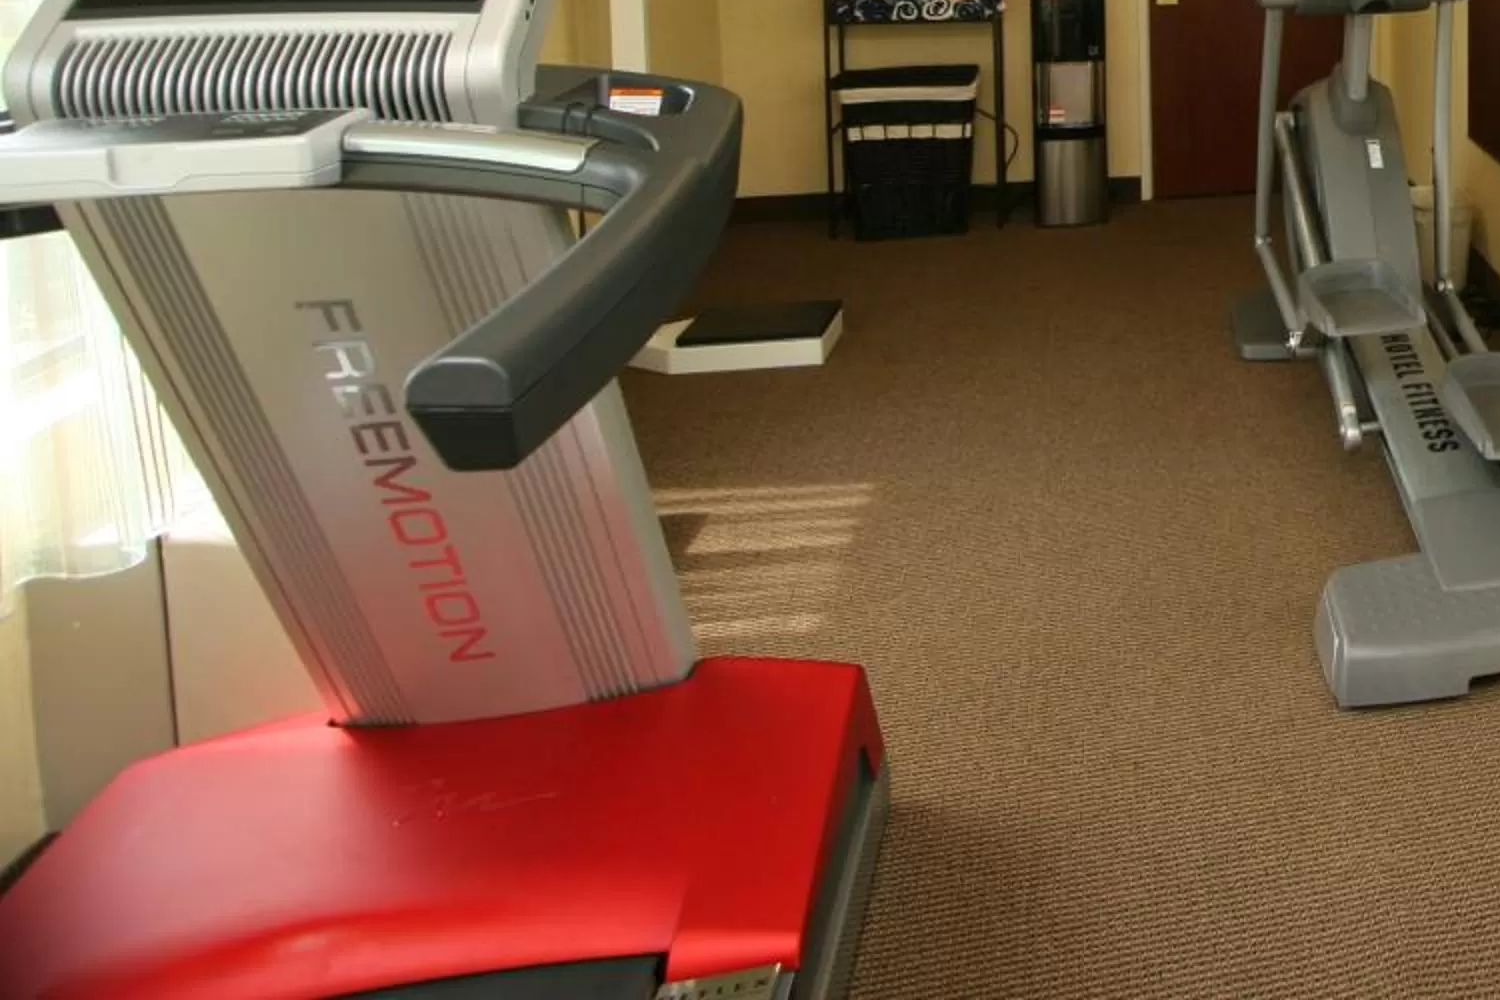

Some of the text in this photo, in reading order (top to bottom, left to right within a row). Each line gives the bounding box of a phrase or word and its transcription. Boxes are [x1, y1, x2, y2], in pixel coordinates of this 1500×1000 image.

[295, 298, 497, 663] FREEMOTION
[1380, 334, 1460, 452] HOTEL FITNESS
